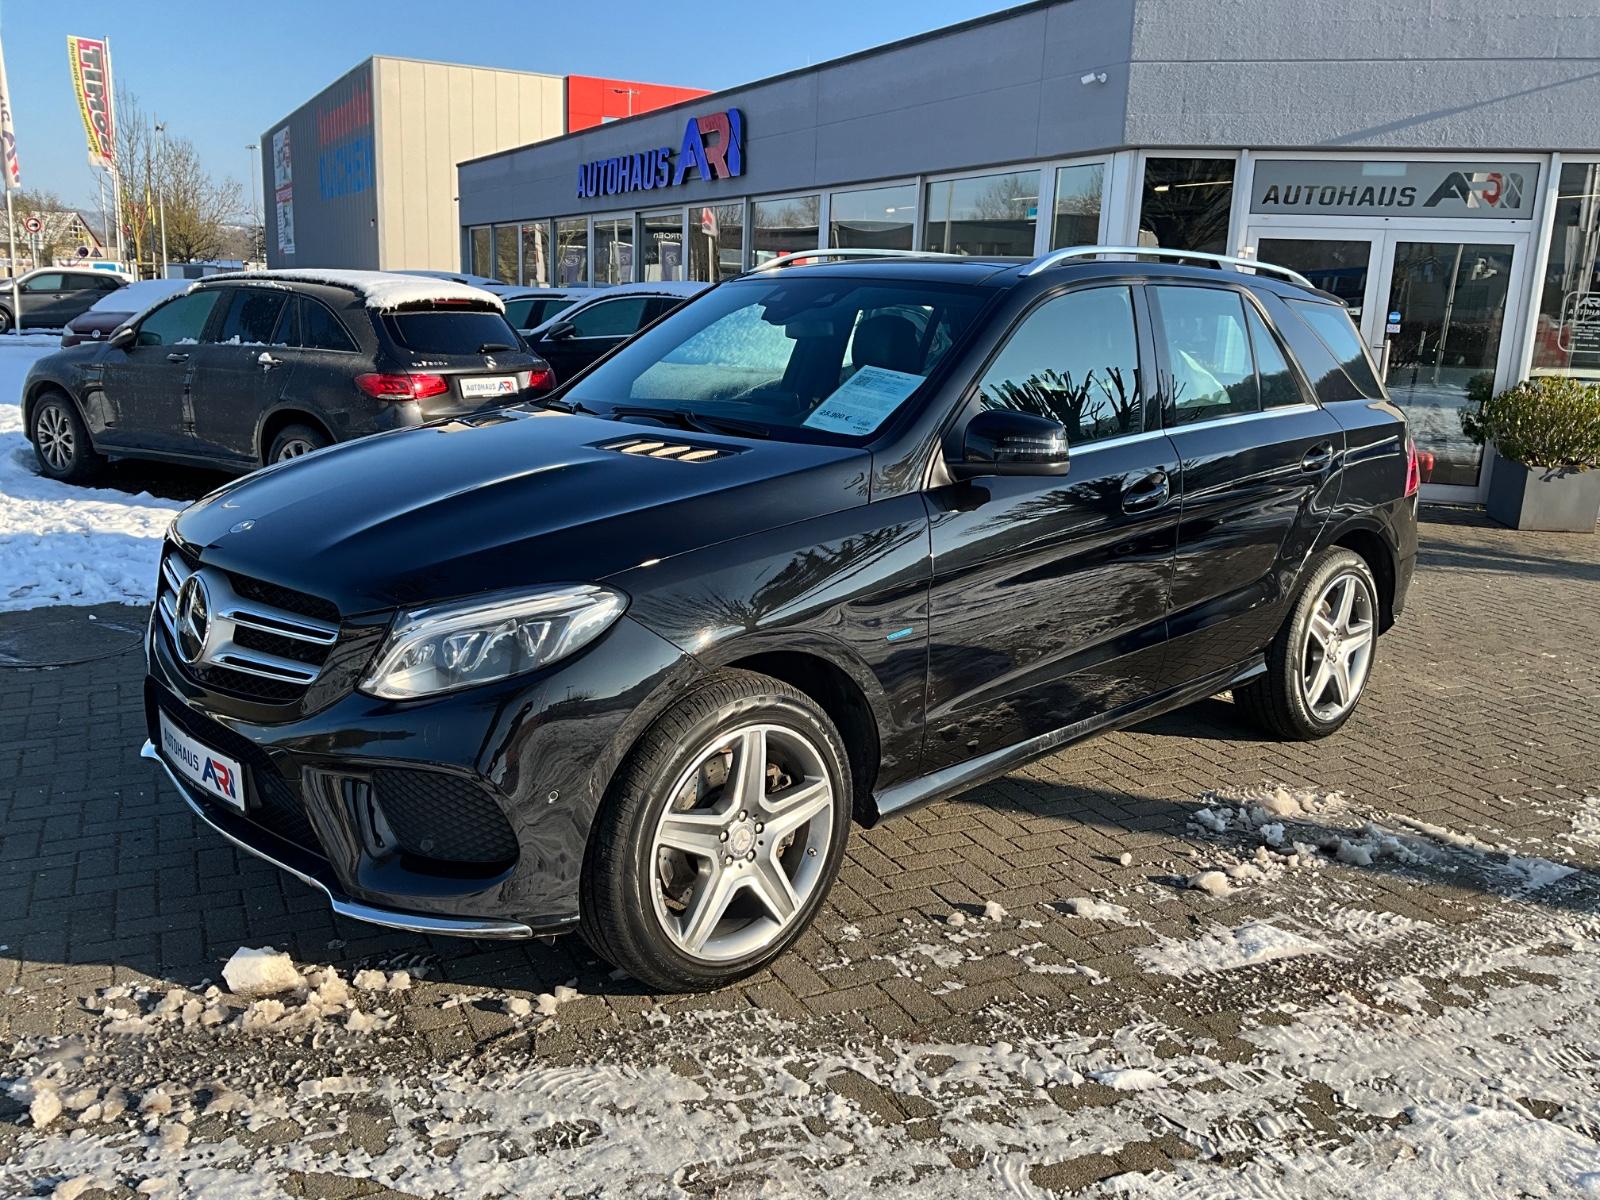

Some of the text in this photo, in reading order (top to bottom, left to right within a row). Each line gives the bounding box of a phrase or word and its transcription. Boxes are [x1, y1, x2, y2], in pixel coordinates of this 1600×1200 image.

[576, 147, 670, 199] AUTOHAUS
[1261, 184, 1417, 208] AUTOHAUS
[465, 382, 497, 392] AUTOHAUS
[164, 728, 200, 772] AUTOHAUS
